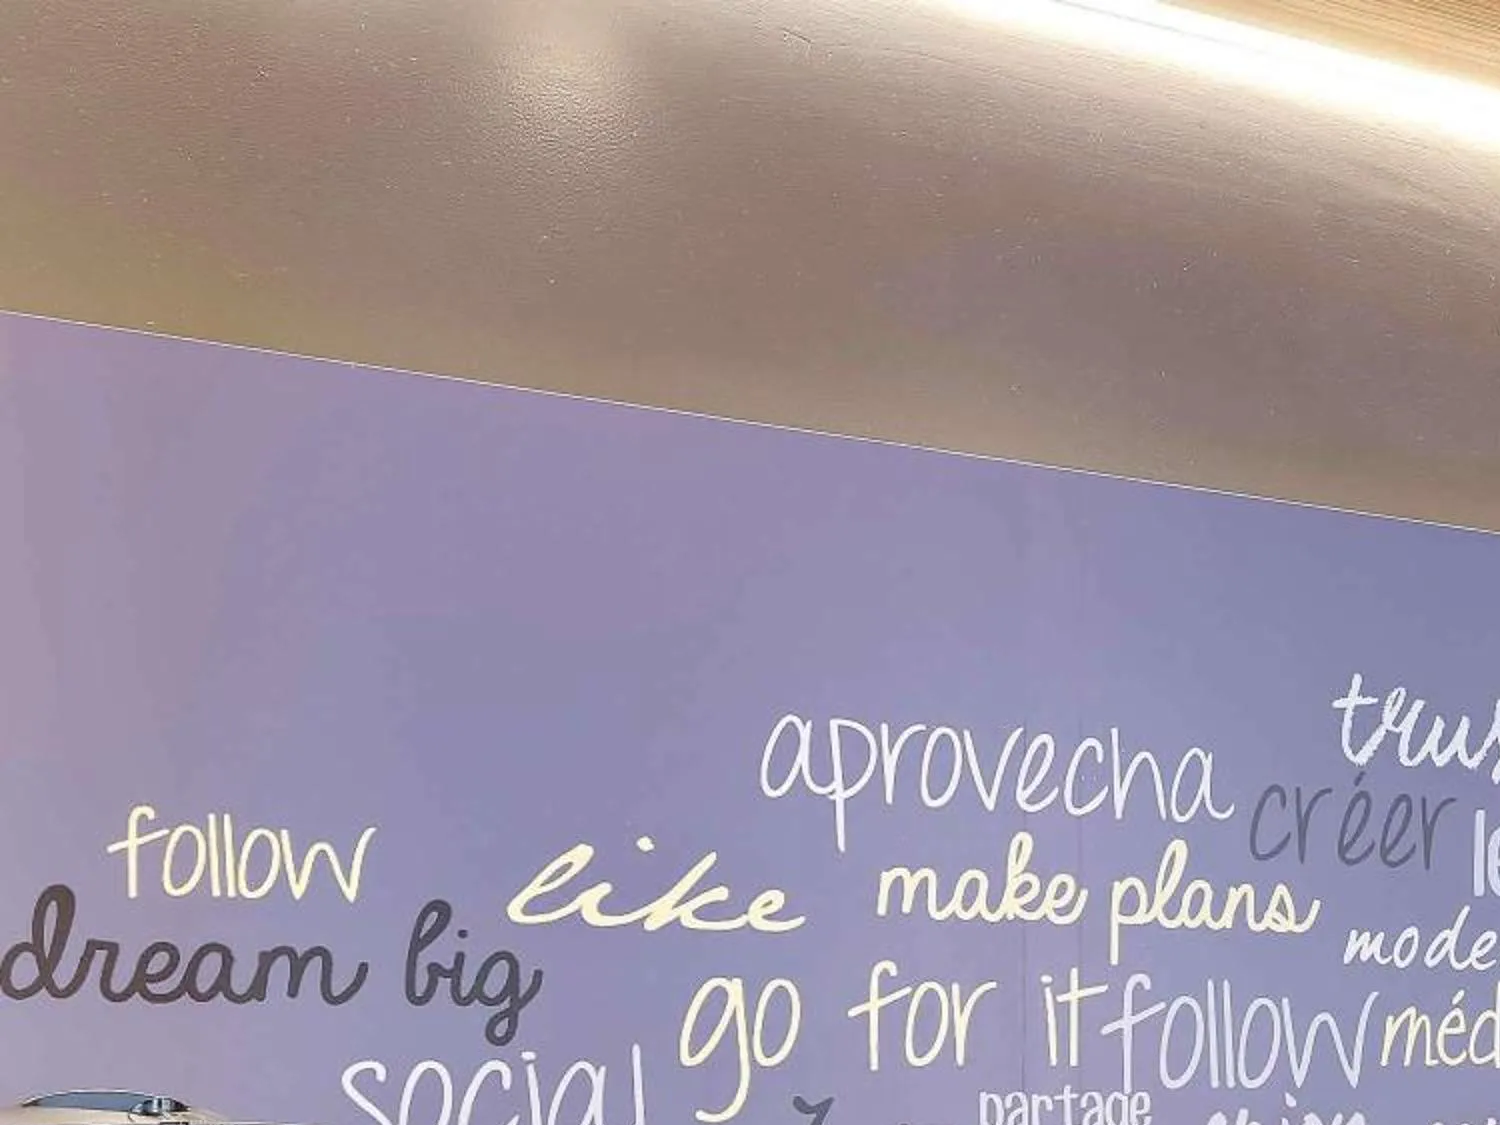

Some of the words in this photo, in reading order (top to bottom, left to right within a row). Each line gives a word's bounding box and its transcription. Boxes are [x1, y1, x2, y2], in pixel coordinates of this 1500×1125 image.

[760, 713, 1235, 853] aprovecha
[1249, 771, 1457, 870] créer
[106, 804, 378, 903] follow
[505, 835, 805, 933] like
[876, 832, 1088, 927] make
[1109, 840, 1322, 965] plans
[0, 884, 369, 1004] dream
[404, 899, 543, 1046] big
[678, 975, 802, 1122] go
[846, 960, 998, 1071] for
[1040, 967, 1110, 1067] it
[1100, 973, 1380, 1093] follow
